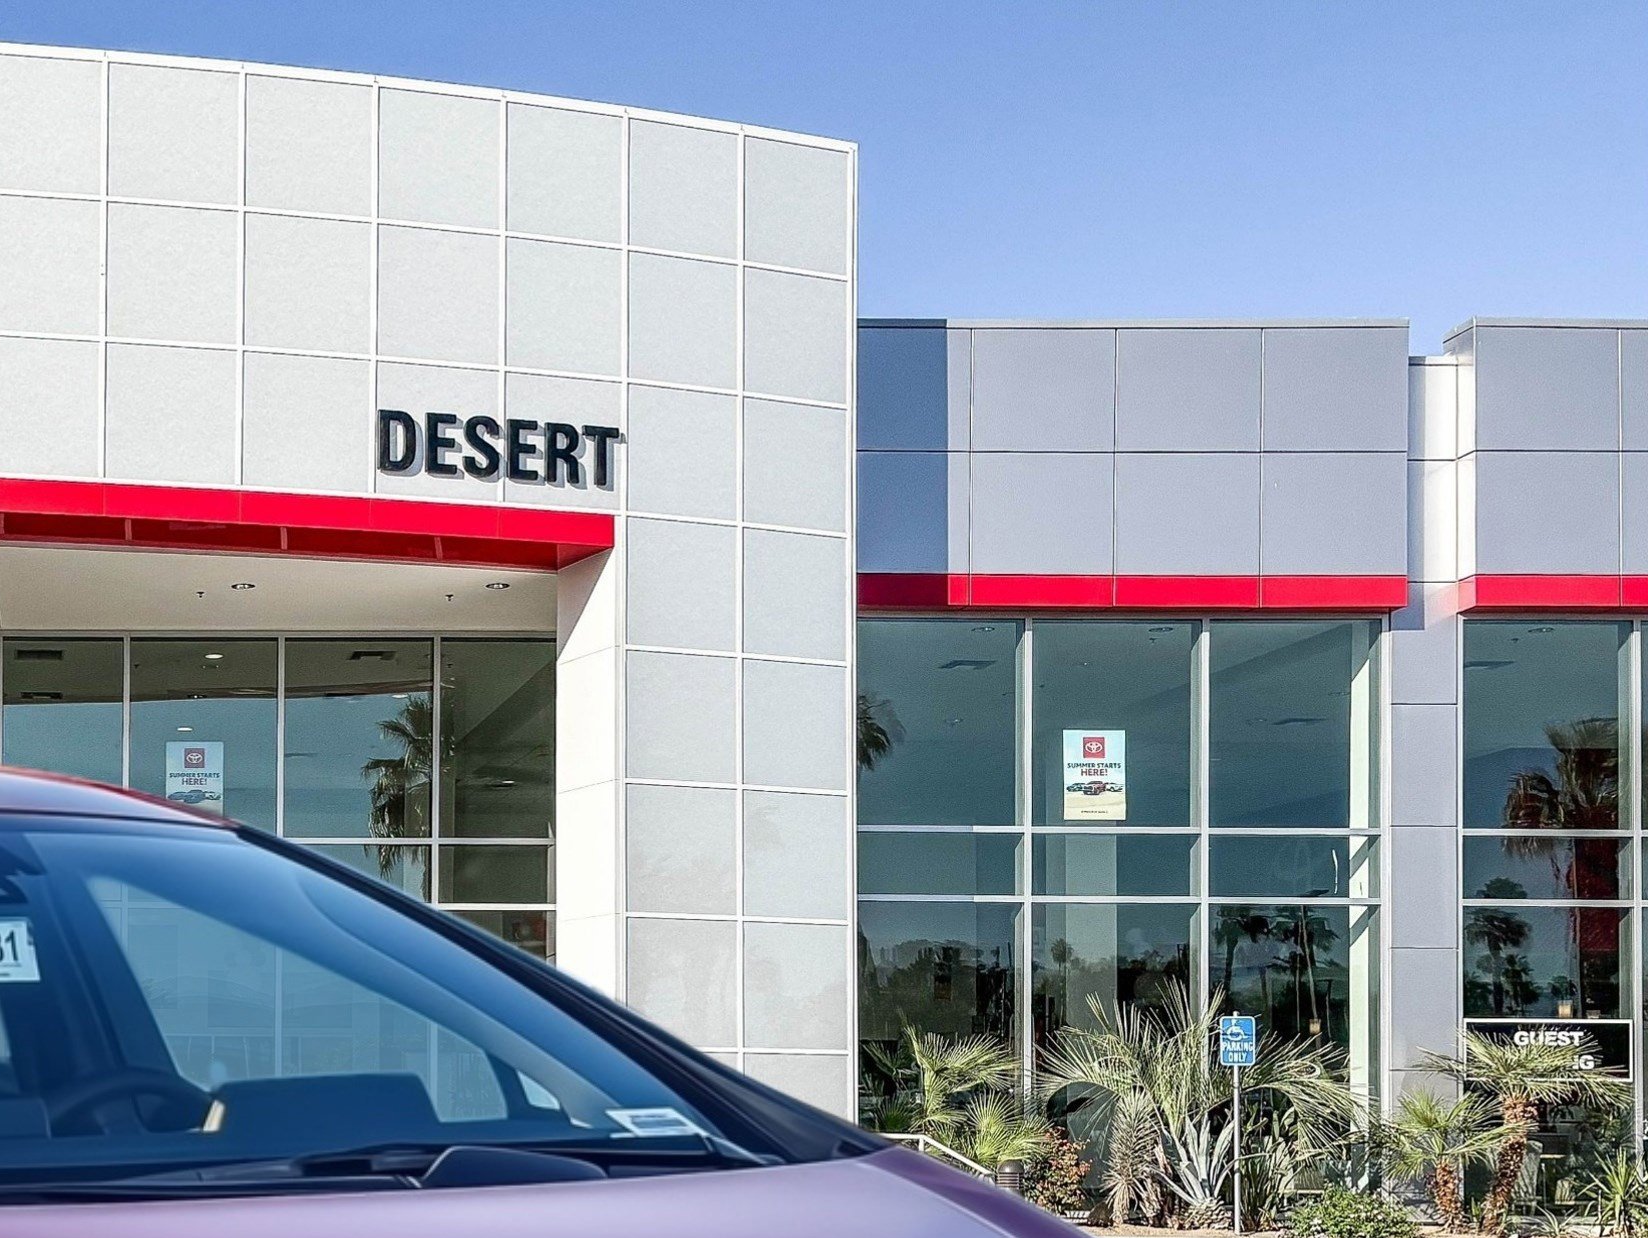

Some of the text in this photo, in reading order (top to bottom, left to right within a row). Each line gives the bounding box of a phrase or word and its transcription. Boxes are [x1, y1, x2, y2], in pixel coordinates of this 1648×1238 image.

[377, 409, 620, 487] DESERT
[181, 778, 208, 786] HERE!
[1513, 1031, 1585, 1047] GUEST
[1222, 1041, 1254, 1051] PARKING
[1228, 1051, 1248, 1062] ONLY
